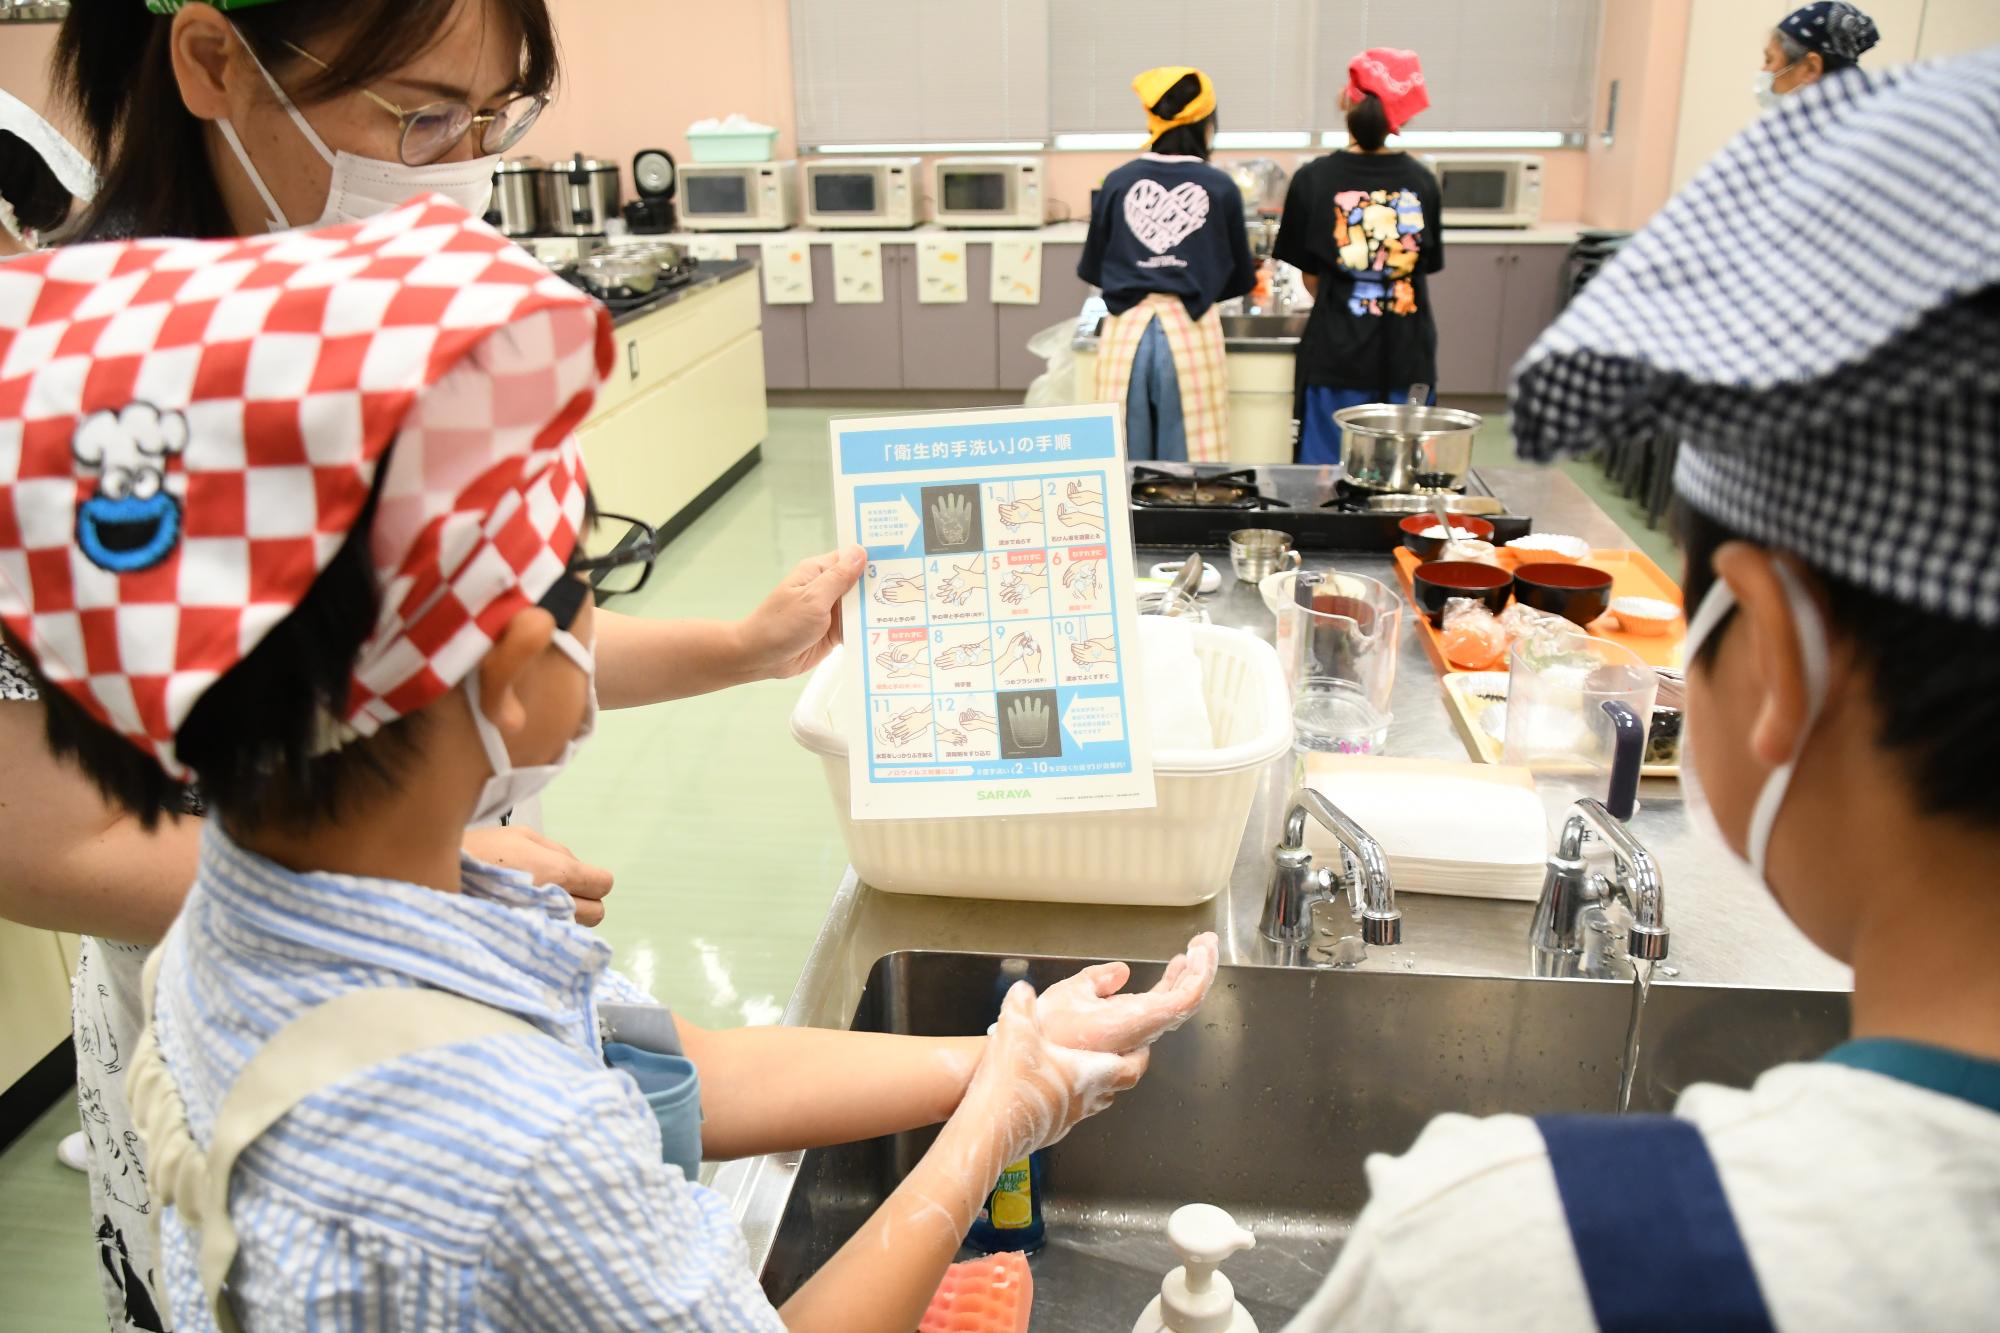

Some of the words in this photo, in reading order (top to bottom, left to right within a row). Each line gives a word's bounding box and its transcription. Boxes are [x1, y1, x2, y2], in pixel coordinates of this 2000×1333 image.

[884, 433, 1072, 462] 「衛生的手洗い」の手順
[988, 486, 994, 499] 1
[1047, 482, 1057, 496] 2
[992, 556, 1001, 570] 5
[1052, 552, 1062, 566] 6
[867, 564, 878, 578] 3
[930, 559, 939, 574] 4
[996, 626, 1005, 639] 9
[1055, 621, 1074, 635] 10
[871, 632, 881, 645] 7
[934, 630, 943, 643] 8
[873, 699, 890, 713] 11
[937, 697, 955, 711] 12
[976, 788, 1032, 801] SARAYA
